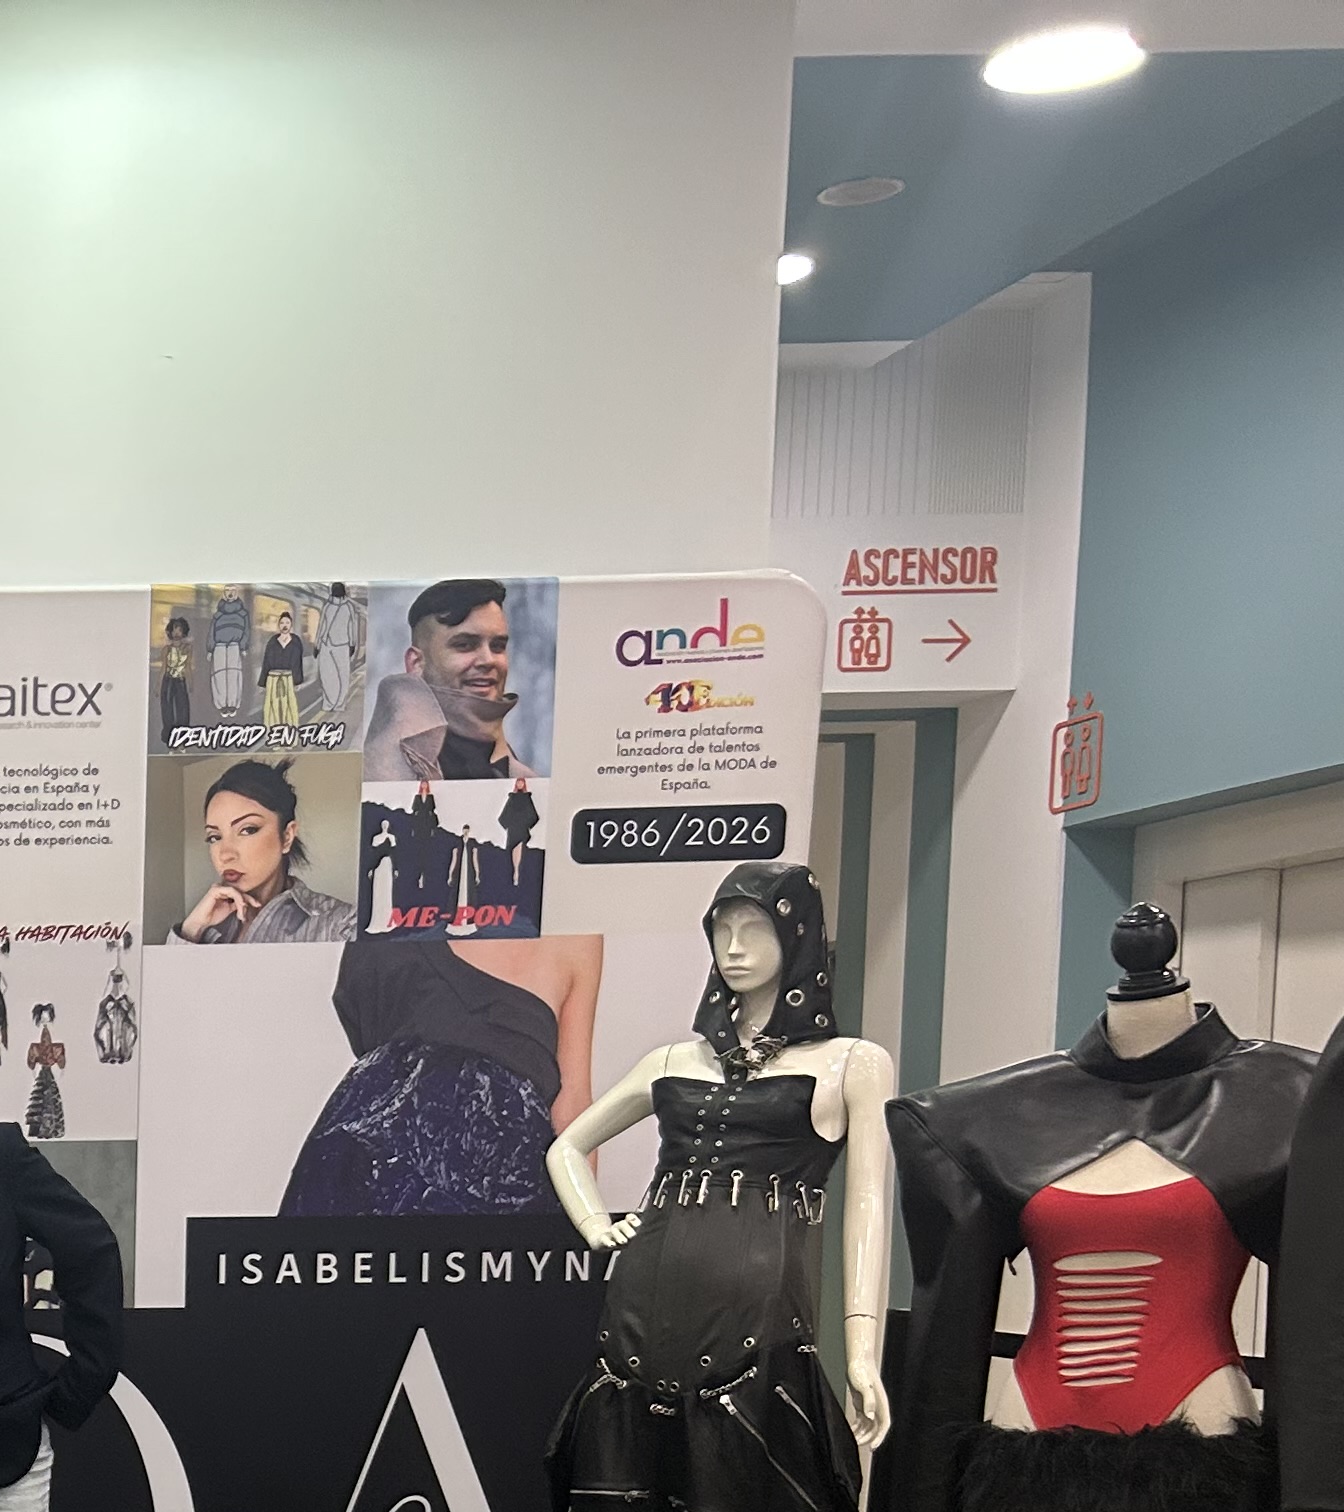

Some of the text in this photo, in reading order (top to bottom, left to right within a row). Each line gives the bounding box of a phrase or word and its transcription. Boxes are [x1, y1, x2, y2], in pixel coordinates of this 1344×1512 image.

[842, 547, 998, 587] ASCENSOR
[615, 597, 766, 667] ande
[167, 723, 346, 750] IDENTIDAD EN FUGA
[616, 721, 763, 745] La primera plataforma
[617, 740, 760, 758] lanzadora de talentos
[3, 763, 78, 783] tecnológico
[82, 762, 99, 777] de
[597, 755, 777, 778] emergentes de la MODA de
[24, 785, 39, 796] en
[43, 781, 89, 800] España
[93, 784, 100, 796] y
[661, 778, 710, 794] España.
[77, 801, 92, 811] en
[97, 798, 120, 810] I+D
[59, 819, 81, 829] con
[86, 816, 110, 828] más
[14, 832, 30, 847] de
[34, 834, 112, 849] experiencia.
[586, 812, 771, 857] 1986/2026
[387, 904, 518, 928] ME-PON
[14, 920, 130, 947] HABITACIÓN
